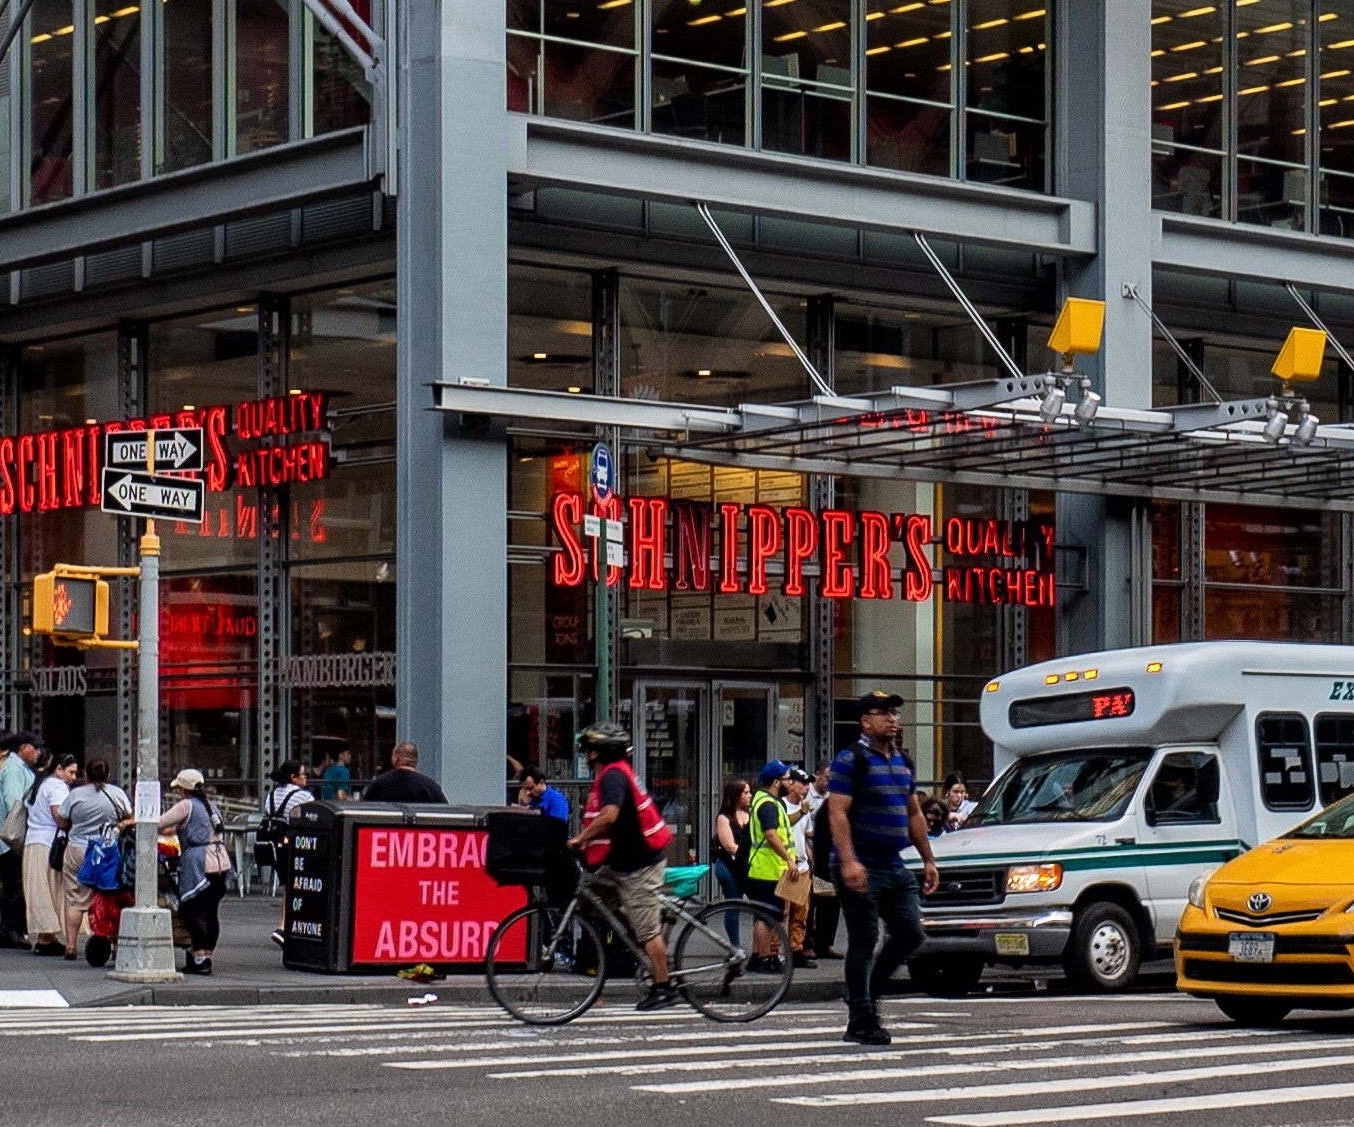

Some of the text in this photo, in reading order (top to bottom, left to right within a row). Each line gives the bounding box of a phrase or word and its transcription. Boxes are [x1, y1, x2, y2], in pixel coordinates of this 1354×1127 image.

[236, 392, 325, 439] QUALITY
[120, 441, 187, 460] ONE WAY
[237, 443, 327, 486] KITCHEN
[118, 484, 190, 507] ONE WAY
[947, 568, 1055, 606] KITCHEN
[29, 664, 87, 697] SALADS
[279, 651, 397, 688] HAMBURGER
[295, 836, 318, 850] DON'T
[294, 857, 305, 870] BE
[293, 877, 322, 893] AFRAID
[419, 880, 459, 905] THE
[292, 899, 303, 911] OF
[291, 920, 322, 937] ANYONE
